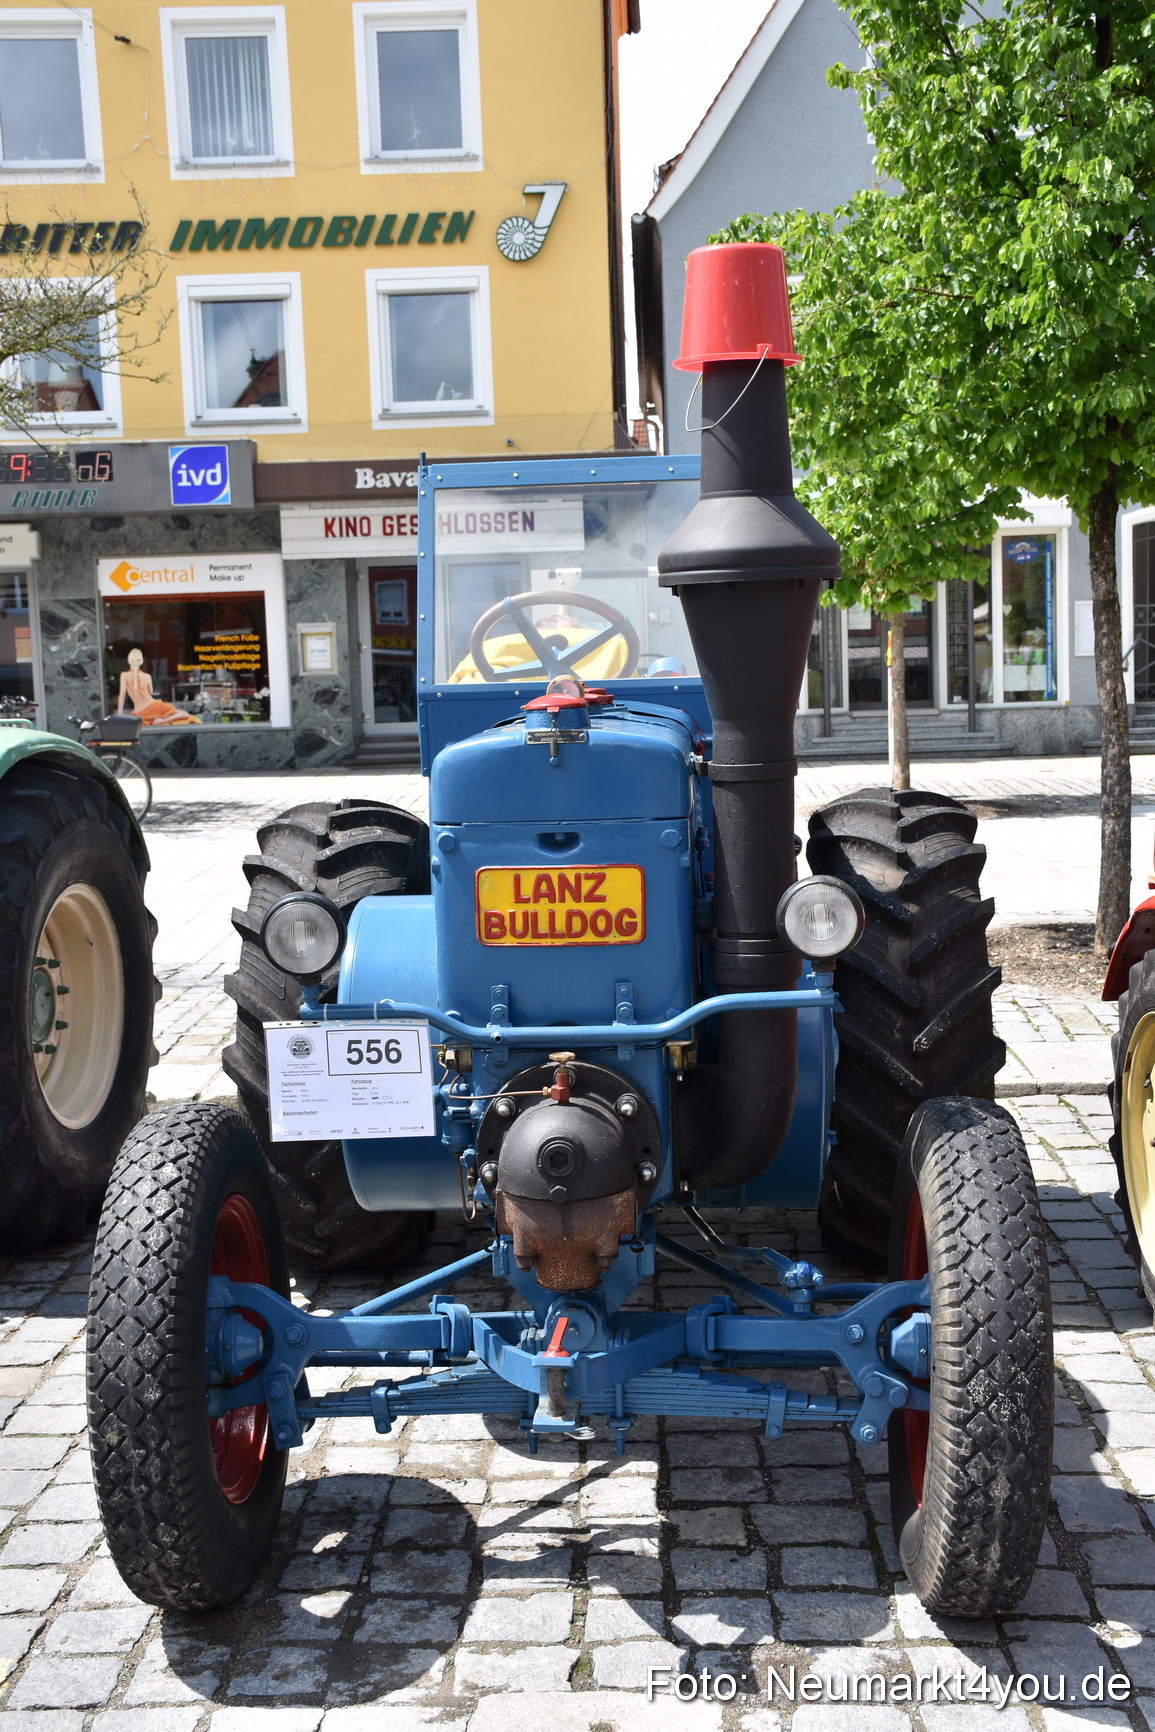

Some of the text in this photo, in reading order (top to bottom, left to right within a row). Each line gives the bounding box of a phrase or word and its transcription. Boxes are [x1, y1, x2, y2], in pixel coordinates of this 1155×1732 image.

[0, 210, 476, 255] RITTER IMMOBILIEN
[177, 463, 222, 487] ivd
[11, 488, 97, 509] RITTER
[324, 511, 536, 538] KINO GESHLOSSEN
[209, 563, 252, 572] Permanent
[209, 574, 245, 582] Make up
[194, 643, 260, 652] Haarverlängerung
[214, 633, 260, 643] French Füße
[177, 662, 261, 672] Kosmetische Fußpflege
[198, 653, 261, 662] Nagelmodellage
[513, 872, 607, 904] LANZ
[484, 908, 638, 940] BULLDOG
[346, 1038, 402, 1065] 556
